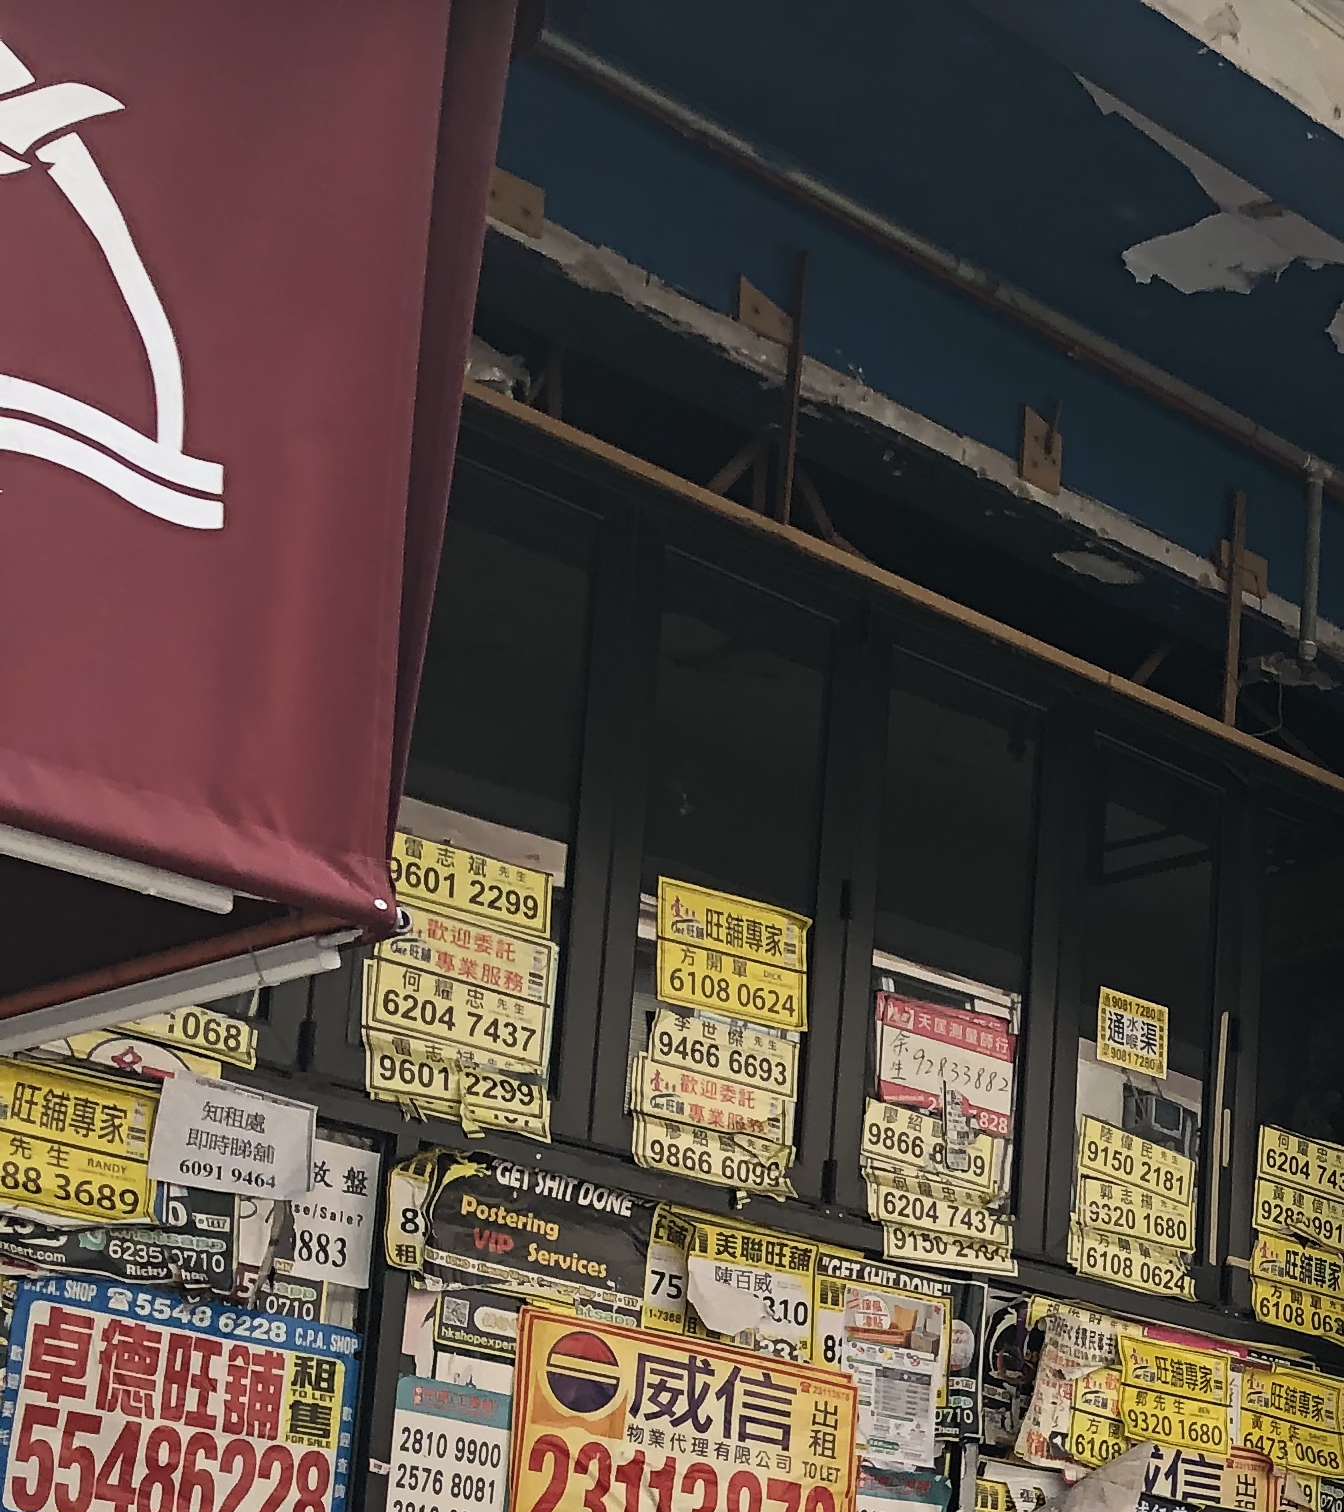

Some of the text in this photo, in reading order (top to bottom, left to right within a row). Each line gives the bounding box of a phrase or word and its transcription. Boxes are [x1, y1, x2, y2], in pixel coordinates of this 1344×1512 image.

[391, 856, 539, 920] 9601 2299
[427, 918, 516, 963] 歡迎委託
[705, 907, 783, 958] 旺舖專家
[669, 968, 795, 1017] 6108 0624
[382, 989, 536, 1052] 6204 7437
[658, 1031, 787, 1086] 9466 6693
[379, 1054, 534, 1106] 9601 2299
[202, 1101, 266, 1134] 知租處
[649, 1138, 712, 1175] 9866
[867, 1123, 924, 1159] 9866
[87, 1157, 128, 1174] RANDY
[179, 1159, 276, 1189] 6091 9464
[1087, 1141, 1184, 1197] 9150 2181
[1265, 1148, 1311, 1181] 6204
[53, 1172, 139, 1215] 3689
[461, 1194, 560, 1241] Postering
[883, 1192, 1000, 1236] 6204 7437
[1143, 1211, 1187, 1242] 1680
[108, 1241, 162, 1264] 6235
[395, 1245, 417, 1264] 租
[527, 1242, 608, 1278] Services
[715, 1231, 813, 1272] 美聯旺舖
[1086, 1247, 1186, 1293] 6108 0624
[63, 1282, 98, 1302] SHOP
[1258, 1297, 1305, 1325] 6108
[134, 1298, 287, 1342] 5548 6228
[295, 1327, 358, 1354] C.P.A. SHOP
[23, 1307, 286, 1441] 卓德旺舖
[291, 1355, 338, 1393] 租
[291, 1389, 335, 1402] TO LET
[627, 1351, 798, 1453] 威信
[288, 1400, 333, 1439] 售
[809, 1400, 839, 1460] 出租
[1127, 1409, 1222, 1446] 9320 1680
[285, 1434, 331, 1448] FOR SALE
[398, 1426, 501, 1468] 2810 9900
[627, 1423, 793, 1475] 物業代理有限公司
[1295, 1442, 1340, 1469] 0068
[395, 1463, 496, 1503] 2576 8081
[802, 1462, 841, 1485] TO LET
